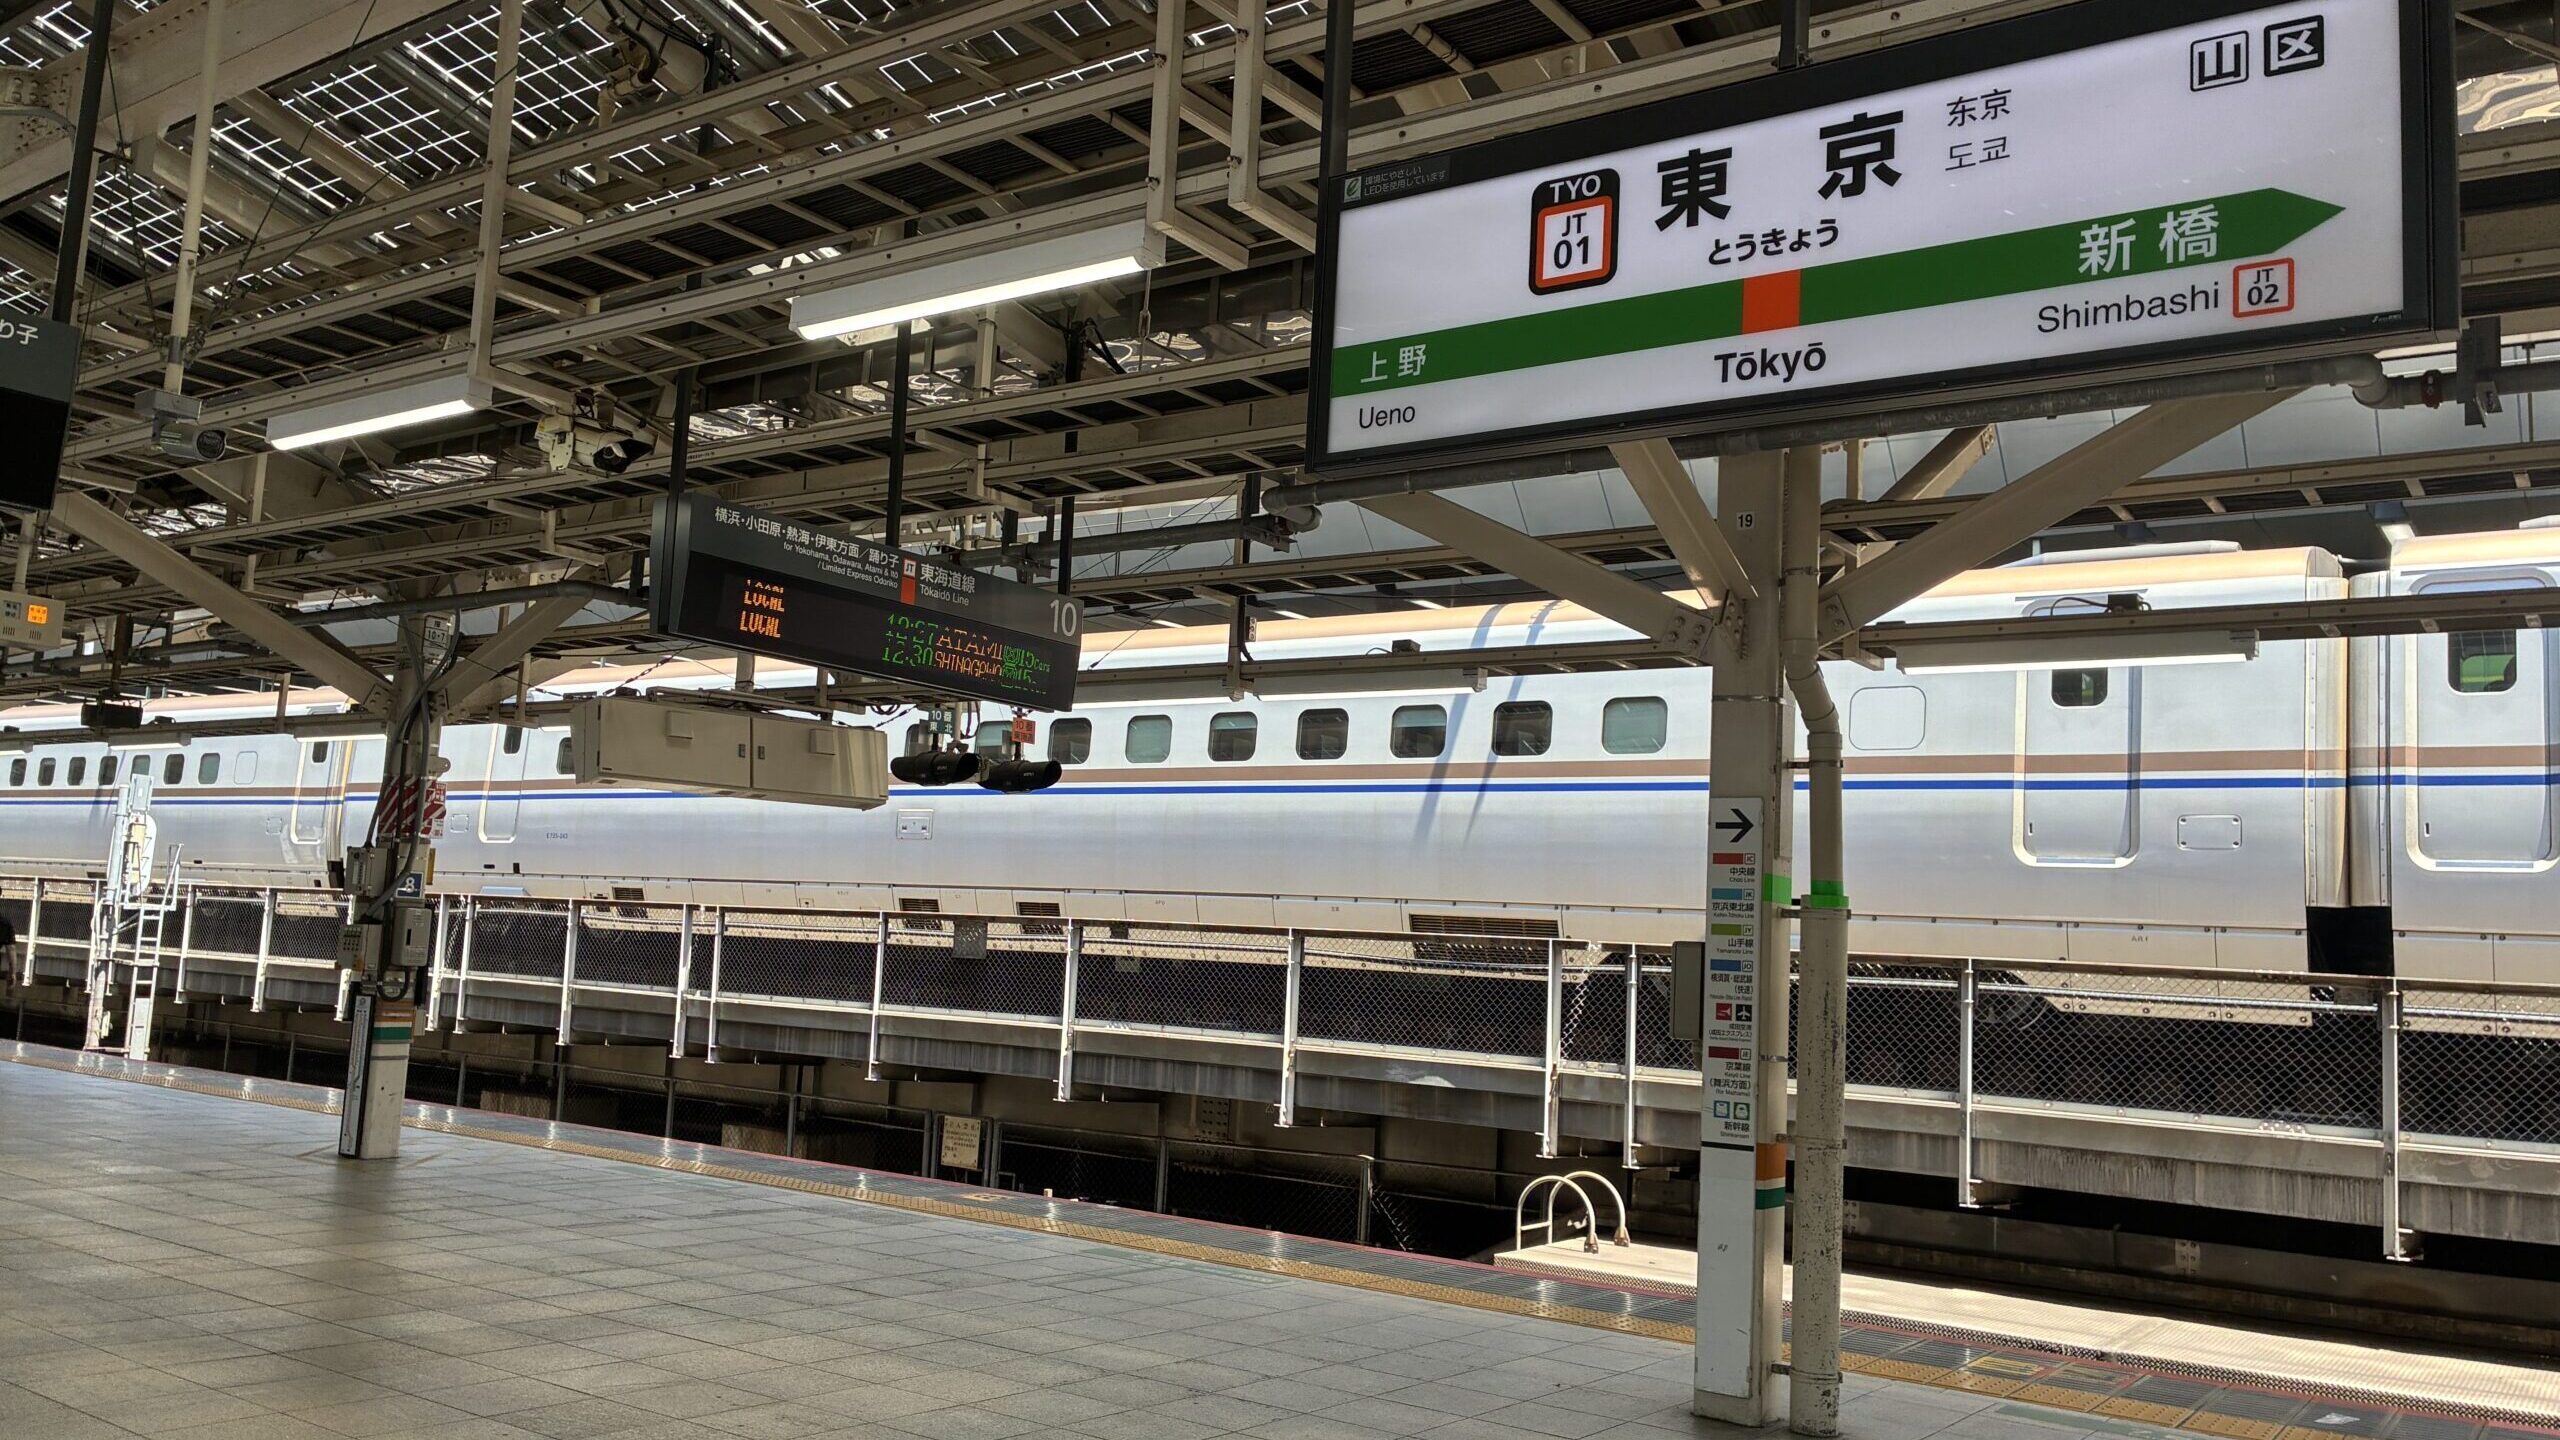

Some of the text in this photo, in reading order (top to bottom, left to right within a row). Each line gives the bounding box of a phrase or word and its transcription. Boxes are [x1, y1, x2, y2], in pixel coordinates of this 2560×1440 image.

[2270, 22, 2319, 71] 区
[1945, 87, 2013, 128] 东京
[1944, 135, 2011, 172] 도쿄
[1655, 110, 1905, 232] 東京
[1549, 174, 1602, 204] TYO
[1560, 212, 1588, 237] JT
[2077, 203, 2220, 277] 新橋
[1552, 236, 1591, 271] 01
[1707, 218, 1840, 266] とうきょう
[2252, 267, 2275, 285] JT
[2036, 281, 2220, 334] Shimbashi
[2245, 283, 2280, 307] 02
[1360, 343, 1428, 385] 上野
[1713, 341, 1828, 386] Tōkyō
[1357, 404, 1417, 430] Ueno
[1737, 513, 1753, 528] 19
[783, 541, 794, 551] for
[795, 544, 831, 563] Yokohama,
[832, 554, 863, 570] Odawara,
[864, 561, 883, 575] Atami
[821, 562, 846, 574] Limited
[847, 569, 873, 583] Express
[873, 575, 899, 588] Odoriko
[919, 563, 976, 594] 東海道線
[952, 592, 970, 606] Line
[1050, 599, 1078, 637] 10
[405, 876, 415, 894] 8
